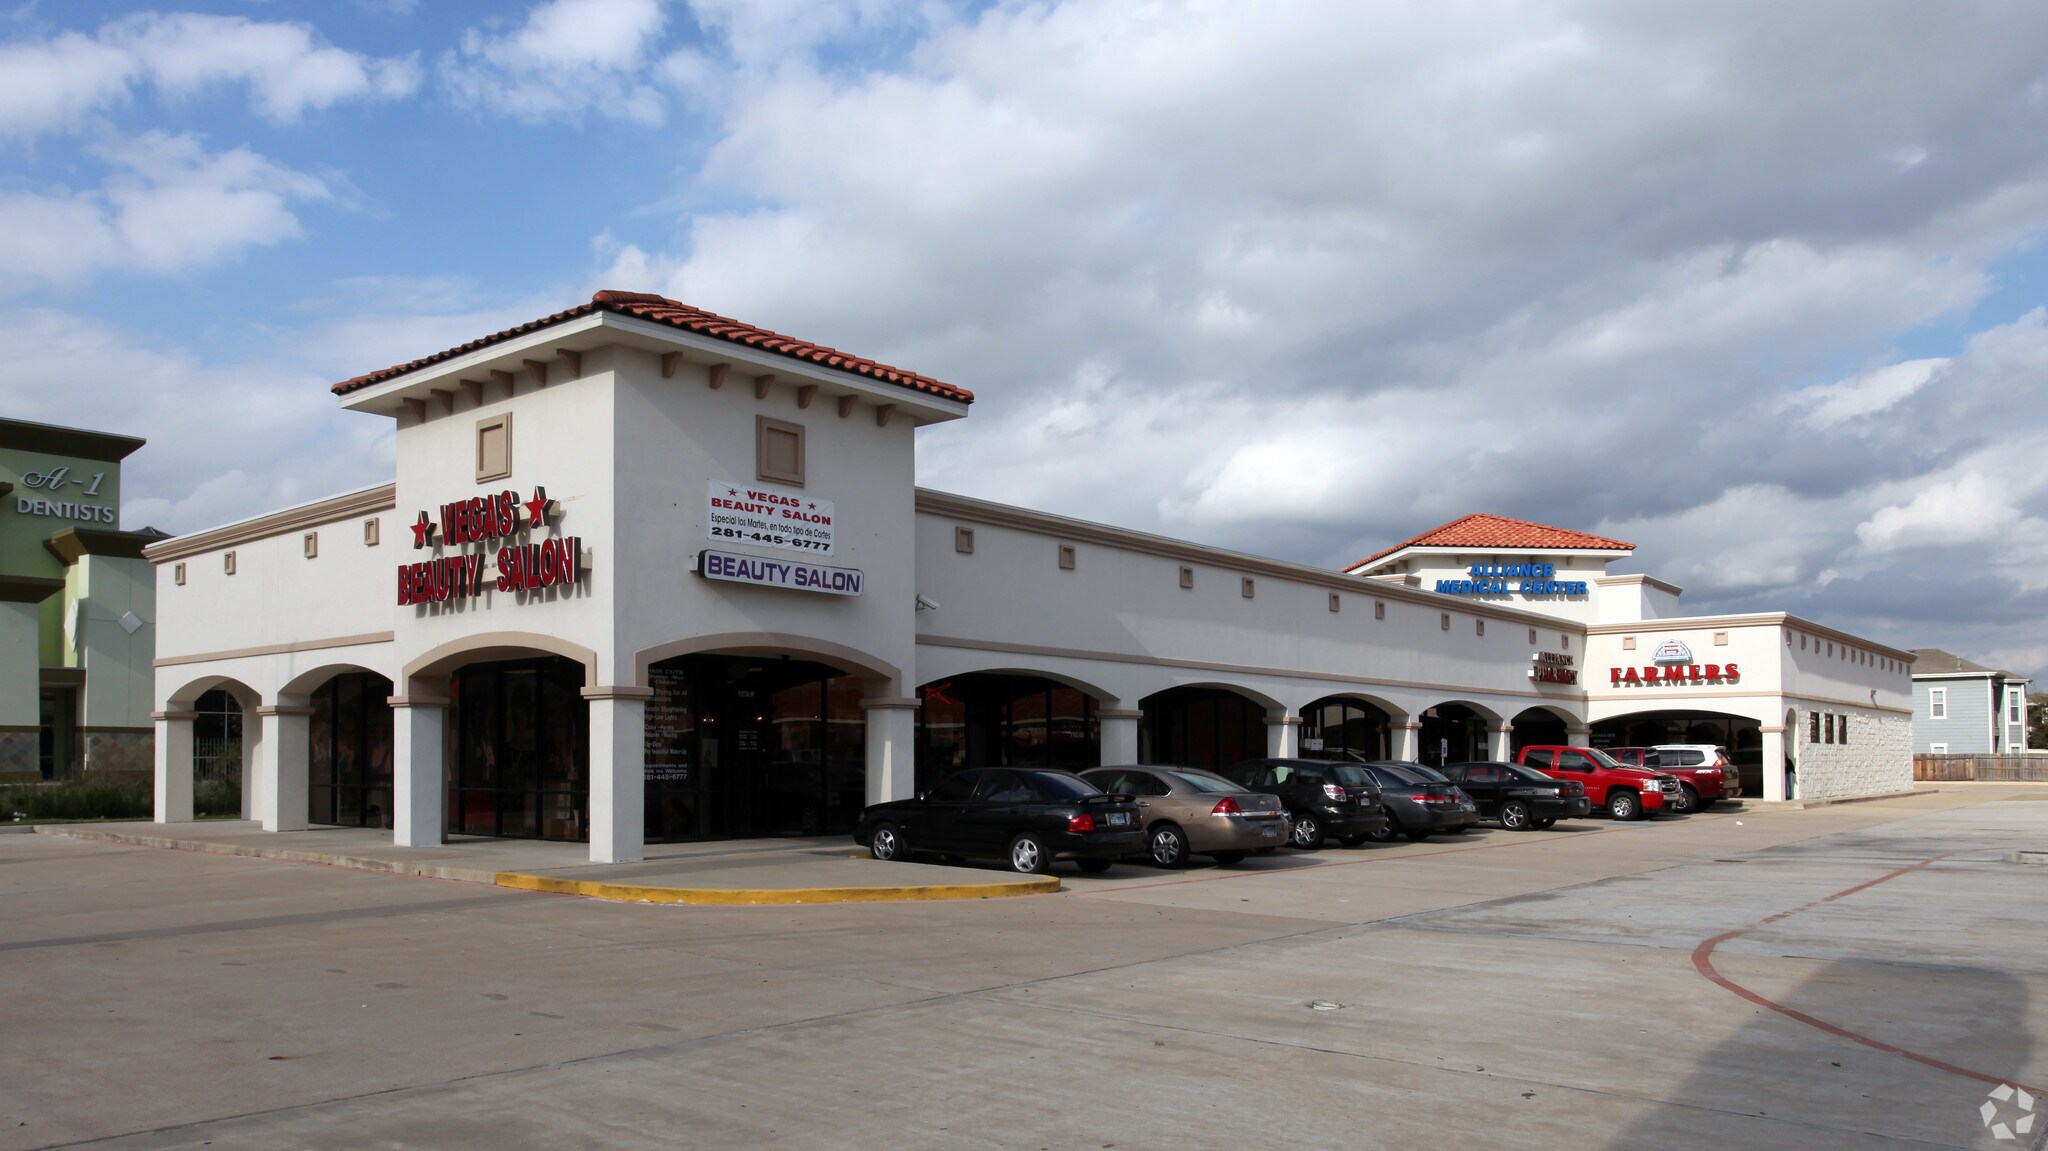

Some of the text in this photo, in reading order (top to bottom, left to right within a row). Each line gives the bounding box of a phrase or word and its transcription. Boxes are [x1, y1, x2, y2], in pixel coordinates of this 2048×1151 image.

[17, 497, 114, 523] DENTISTS
[711, 497, 831, 525] BEAUTY SALON
[747, 490, 800, 508] VEGAS
[440, 490, 520, 546] VEGAS
[711, 512, 736, 525] Especial
[738, 516, 746, 527] los
[770, 523, 778, 531] en
[778, 523, 792, 534] todo
[792, 526, 804, 536] tipo
[804, 528, 812, 537] de
[814, 529, 831, 540] Cortes
[711, 527, 831, 551] 281-445-6777
[398, 536, 581, 606] BEAUTY SALON
[708, 554, 860, 592] BEAUTY SALON
[1470, 563, 1554, 577] ALLIANCE
[1435, 579, 1587, 595] MEDICAL CENTER
[1540, 651, 1573, 666] ALLIANCE
[1610, 663, 1740, 683] FARMERS
